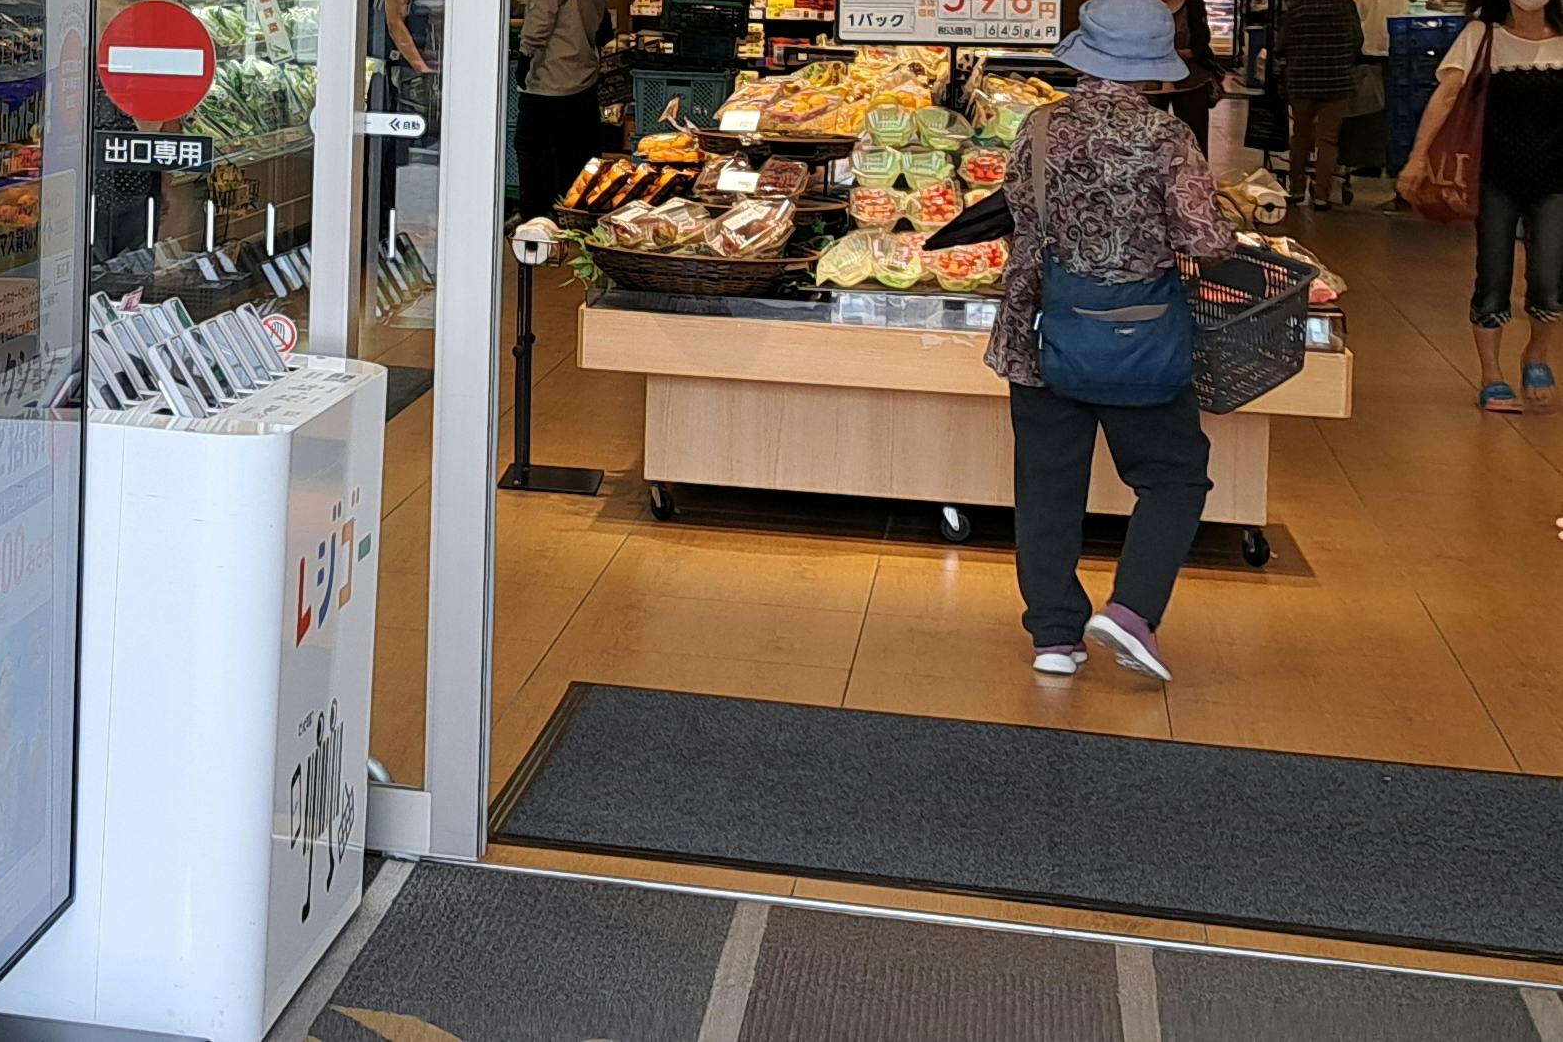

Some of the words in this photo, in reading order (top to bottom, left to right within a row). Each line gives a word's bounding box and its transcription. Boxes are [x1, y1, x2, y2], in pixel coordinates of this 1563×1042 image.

[403, 121, 421, 131] 自動
[105, 137, 202, 166] 出口専用
